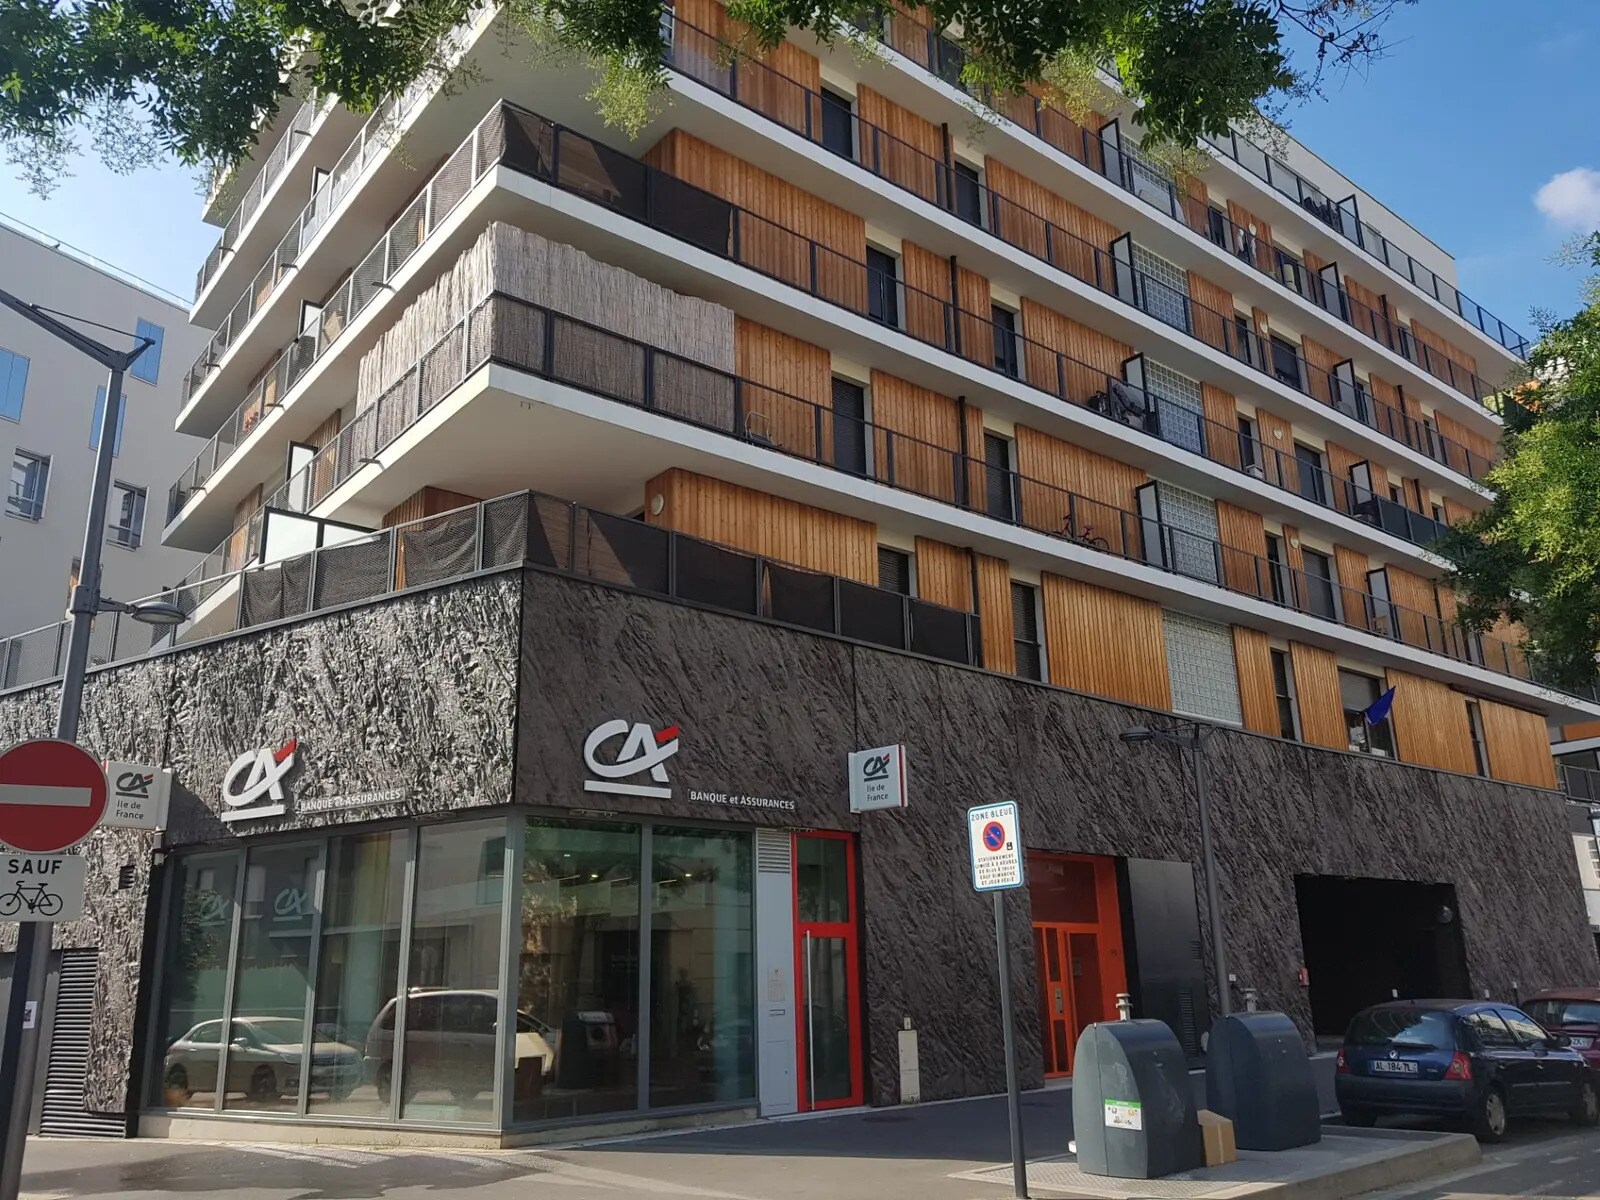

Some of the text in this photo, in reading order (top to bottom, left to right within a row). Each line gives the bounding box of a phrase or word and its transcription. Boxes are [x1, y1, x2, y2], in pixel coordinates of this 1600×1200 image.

[301, 799, 333, 812] BANQUE
[345, 788, 401, 805] ASSURANCES
[690, 791, 795, 810] BANQUE et ASSURANCES
[867, 793, 889, 801] France
[130, 801, 141, 809] de
[116, 809, 144, 820] France
[971, 807, 1013, 821] ZONE BLEUE
[8, 858, 62, 875] SAUF
